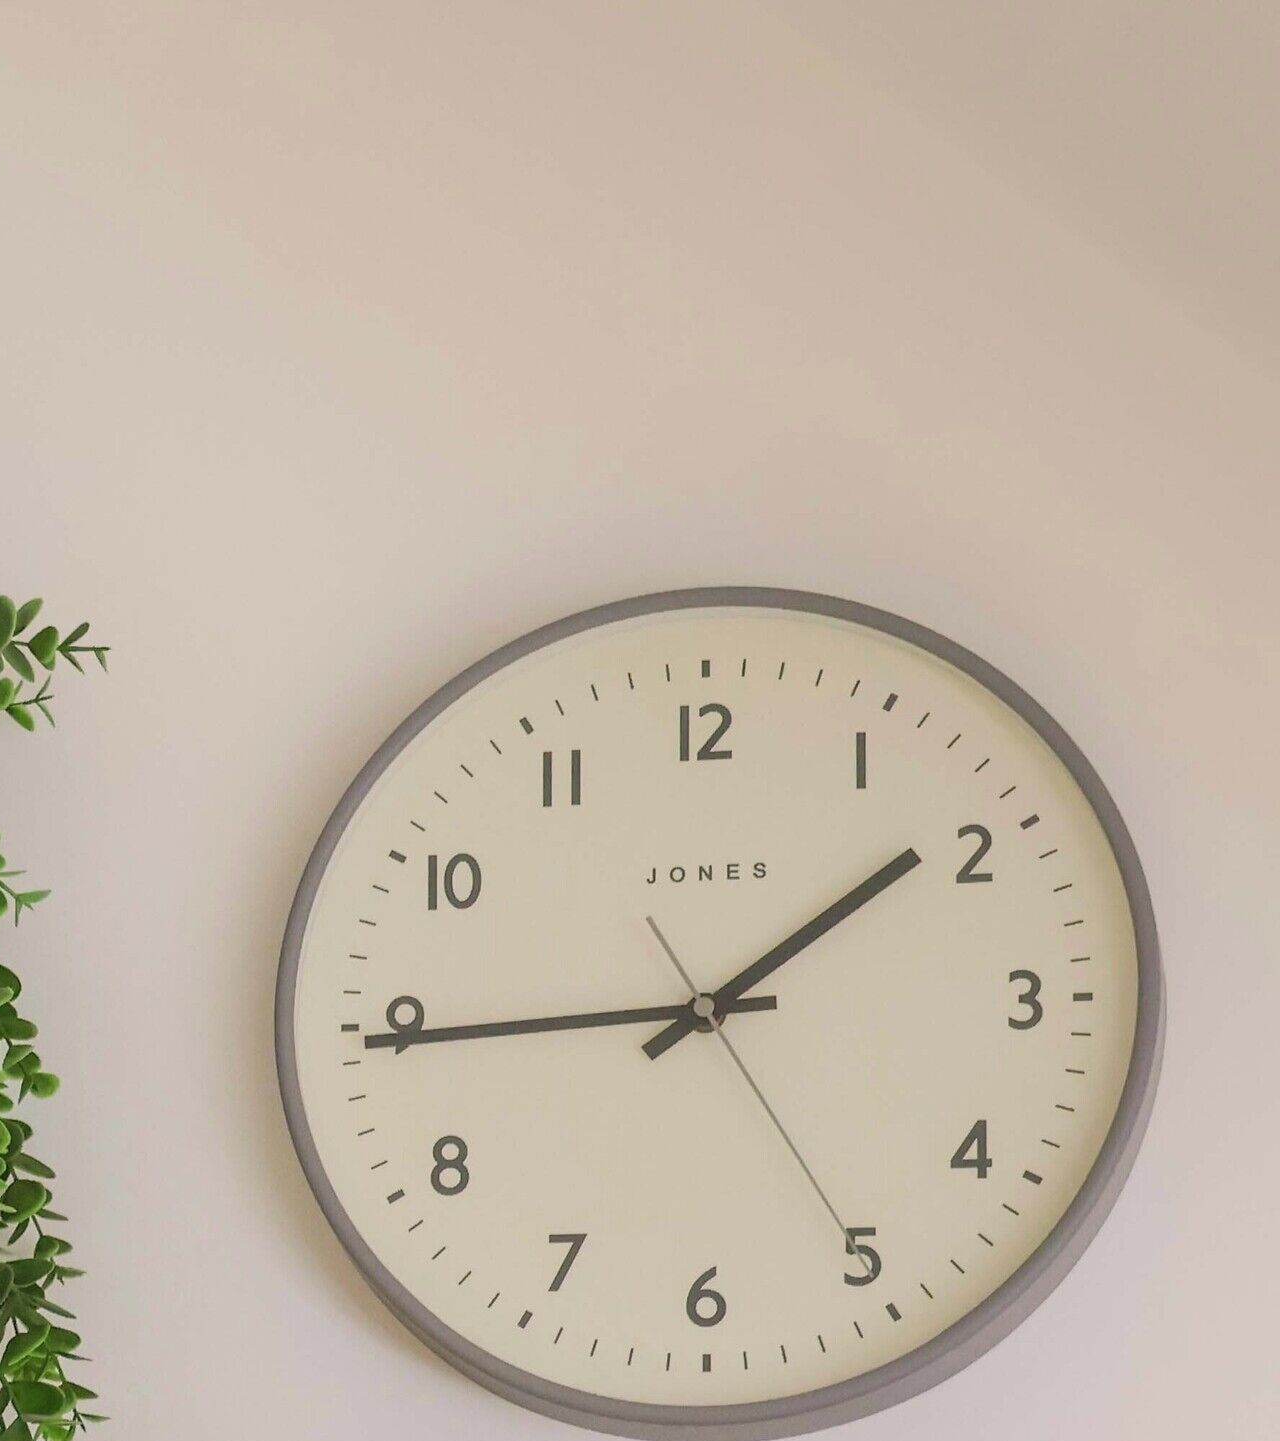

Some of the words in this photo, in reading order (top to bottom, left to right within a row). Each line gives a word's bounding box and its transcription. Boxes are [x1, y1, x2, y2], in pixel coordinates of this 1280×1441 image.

[679, 702, 734, 762] 12
[855, 731, 868, 789] 1
[542, 749, 582, 808] 11
[426, 852, 483, 911] 10
[646, 862, 767, 884] JONES
[955, 823, 994, 884] 2
[385, 995, 425, 1055] 9
[1006, 969, 1044, 1031] 3
[430, 1135, 471, 1196] 8
[950, 1119, 994, 1180] 4
[547, 1232, 588, 1292] 7
[843, 1226, 882, 1287] 5
[685, 1265, 728, 1328] 6
